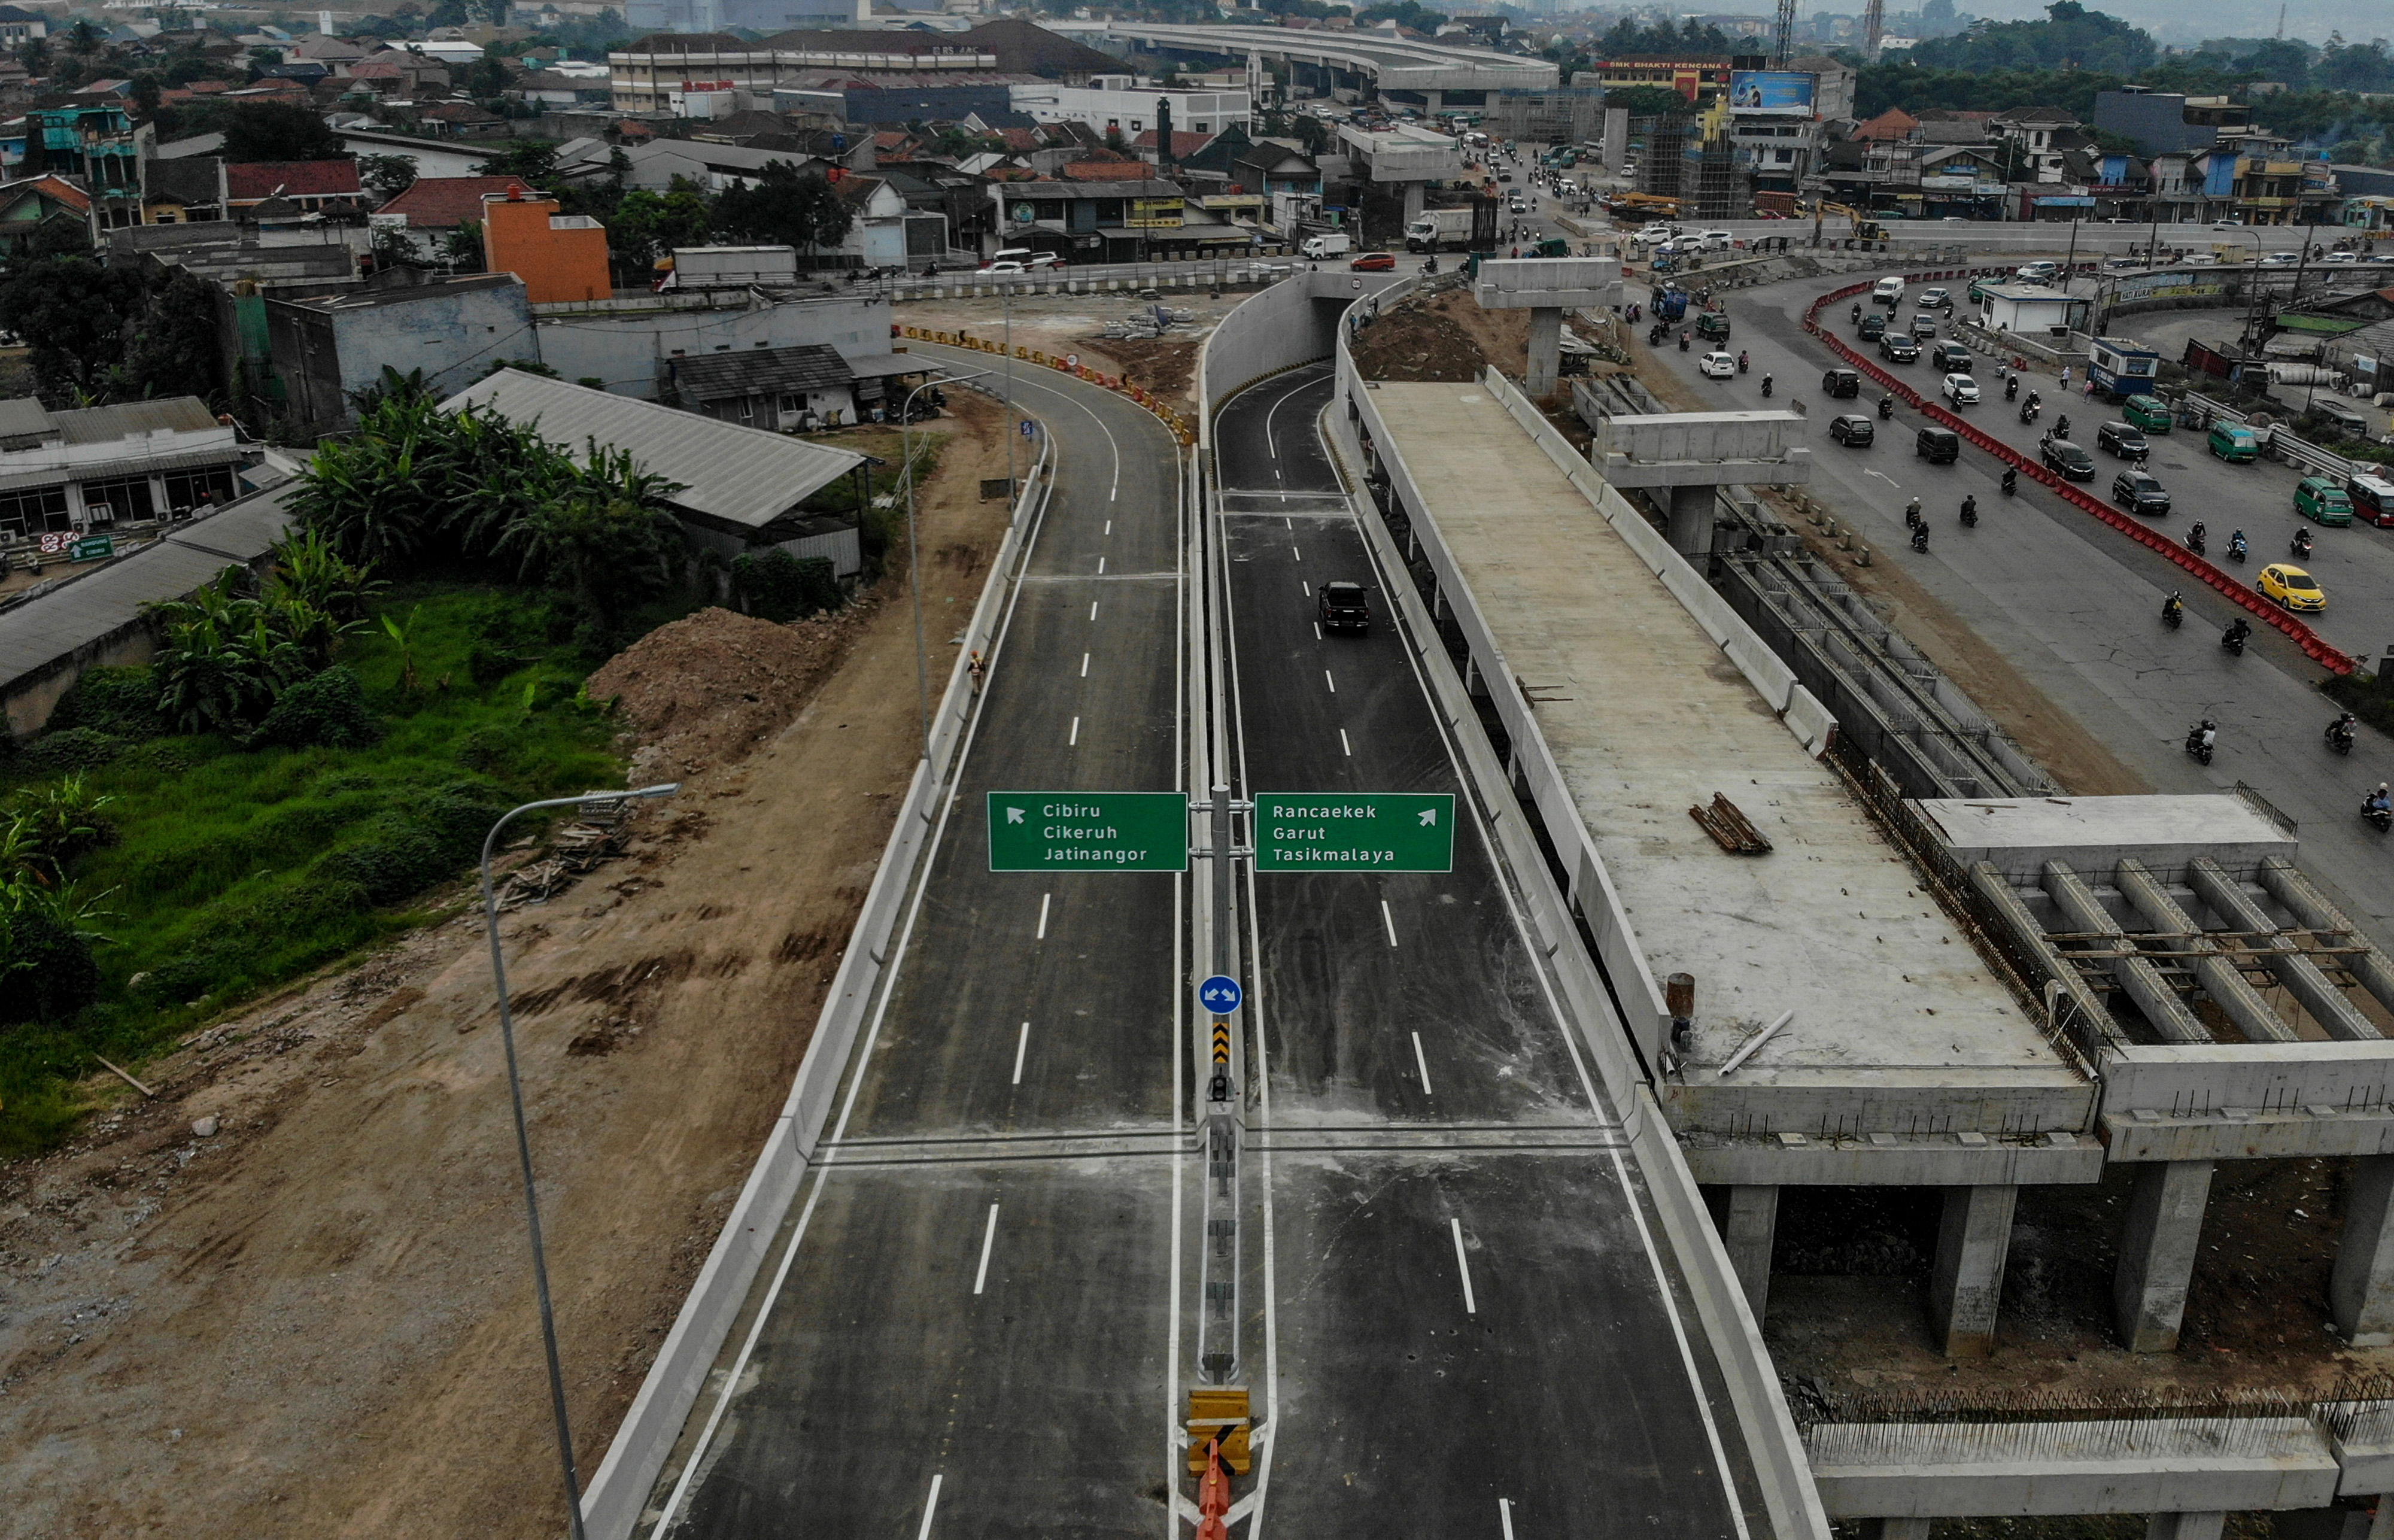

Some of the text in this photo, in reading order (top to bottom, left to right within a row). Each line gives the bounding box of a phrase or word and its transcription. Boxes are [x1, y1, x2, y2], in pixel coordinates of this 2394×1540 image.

[1043, 804, 1100, 817] Cibiru
[1273, 805, 1376, 818] Rancaekek
[1044, 825, 1117, 839] Cikeruh
[1273, 827, 1325, 839] Garut
[1044, 847, 1147, 863] Jatinangor
[1273, 848, 1394, 864] Tasikmalaya
